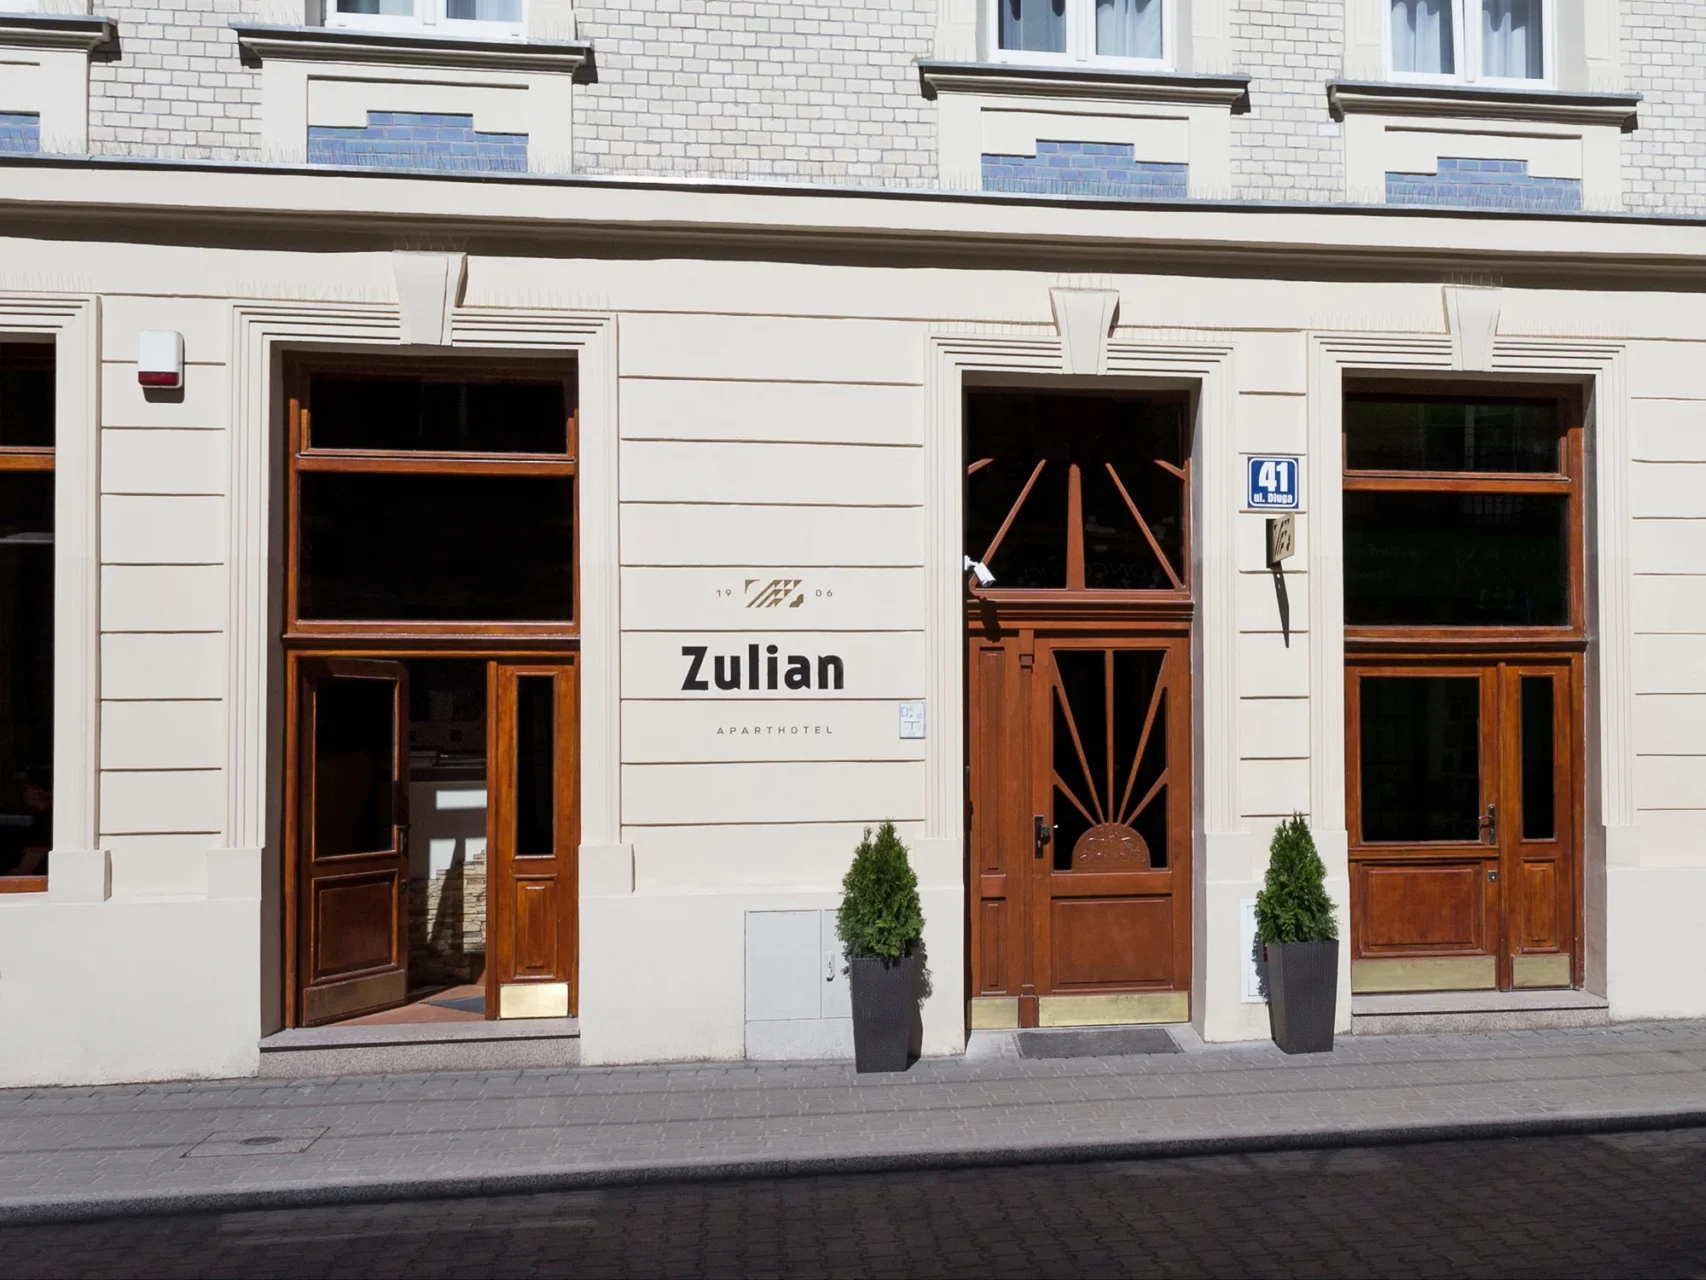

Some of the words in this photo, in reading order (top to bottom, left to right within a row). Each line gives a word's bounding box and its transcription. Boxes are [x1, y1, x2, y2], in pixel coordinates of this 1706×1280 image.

[1258, 461, 1289, 492] 41
[1253, 492, 1266, 503] ul.
[716, 588, 732, 598] 19
[815, 588, 833, 598] 06
[681, 644, 845, 690] Zulian
[716, 726, 833, 736] APARTHOTEL
